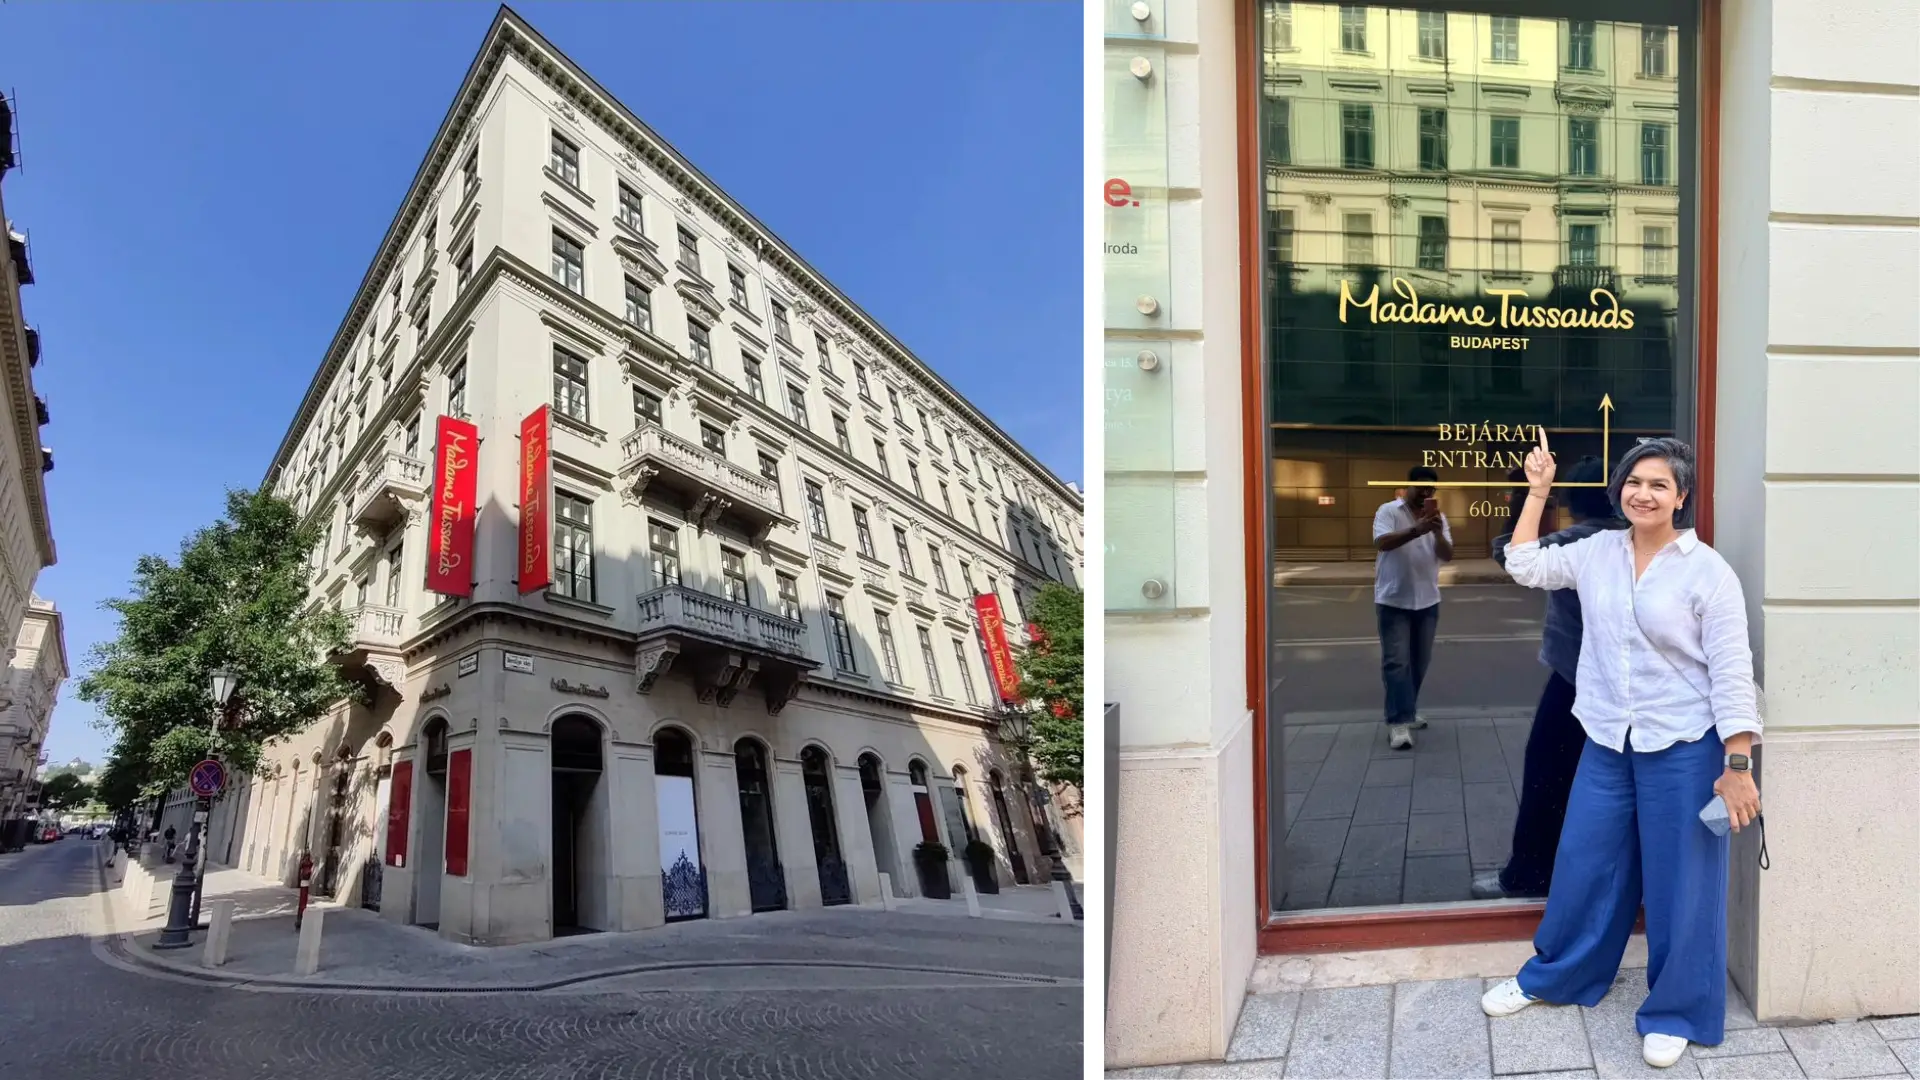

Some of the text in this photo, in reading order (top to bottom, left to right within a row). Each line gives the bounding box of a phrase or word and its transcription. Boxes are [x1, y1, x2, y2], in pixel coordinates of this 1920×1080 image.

[1339, 277, 1635, 329] Madame Tussauds
[1450, 336, 1530, 350] BUDAPEST
[1438, 420, 1542, 446] BEJÁRAT
[1422, 449, 1557, 469] ENTRAN
[438, 430, 468, 576] Madame Tussauds
[524, 423, 542, 574] Madame Tussauds
[1469, 500, 1512, 517] 60m
